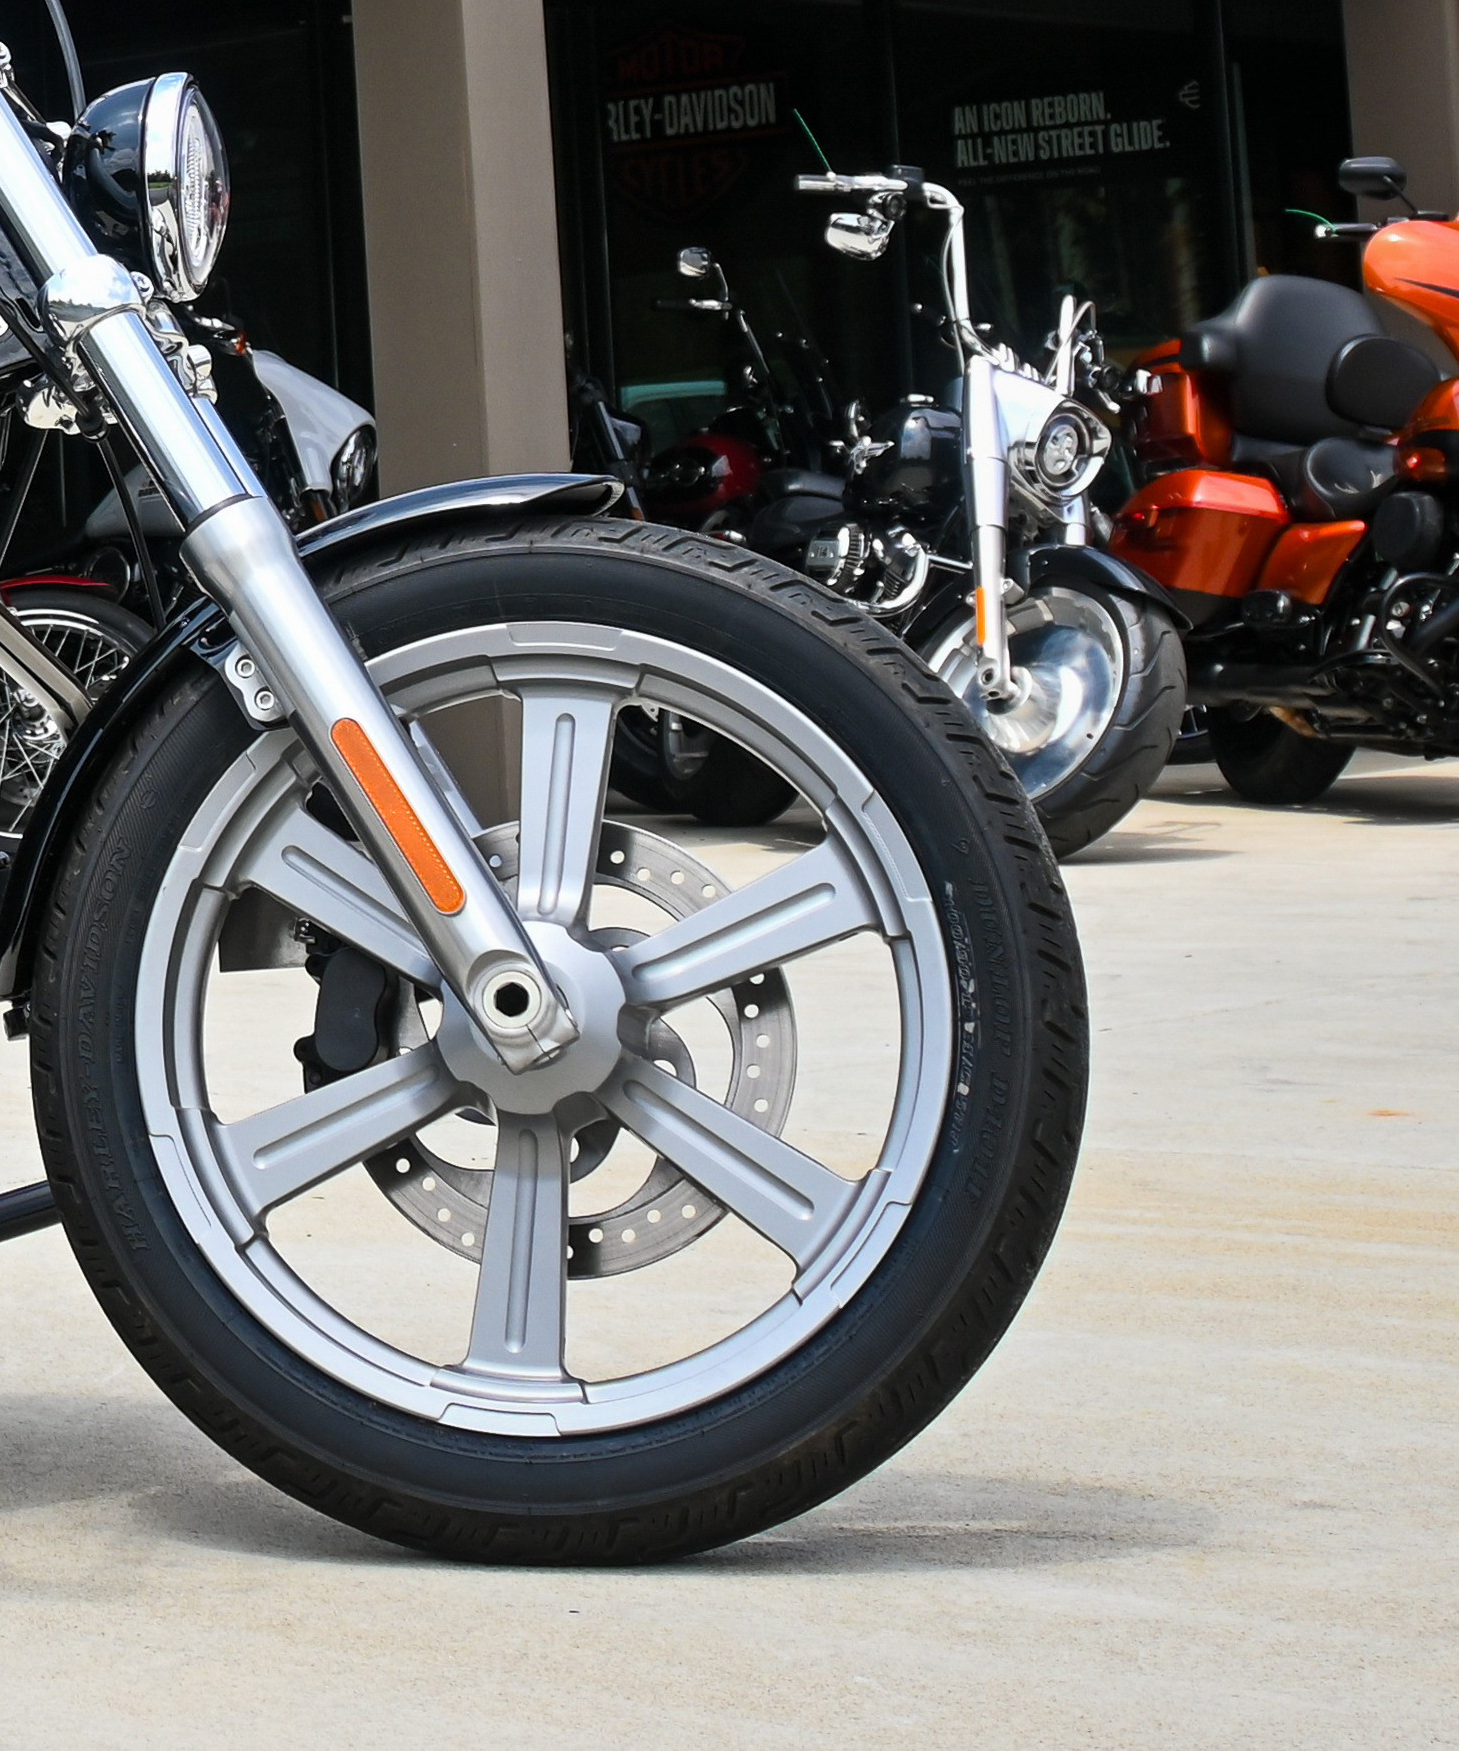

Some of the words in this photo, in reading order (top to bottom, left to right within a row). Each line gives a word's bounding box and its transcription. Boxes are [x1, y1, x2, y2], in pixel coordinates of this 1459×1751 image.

[953, 105, 979, 135] AN
[982, 99, 1027, 132] ICON
[1031, 91, 1112, 127] REBORN.
[956, 132, 1036, 169] ALL-NEW
[1038, 124, 1106, 161] STREET
[1109, 119, 1171, 153] GLIDE.
[76, 834, 152, 1253] HARLEY-DAVIDSON
